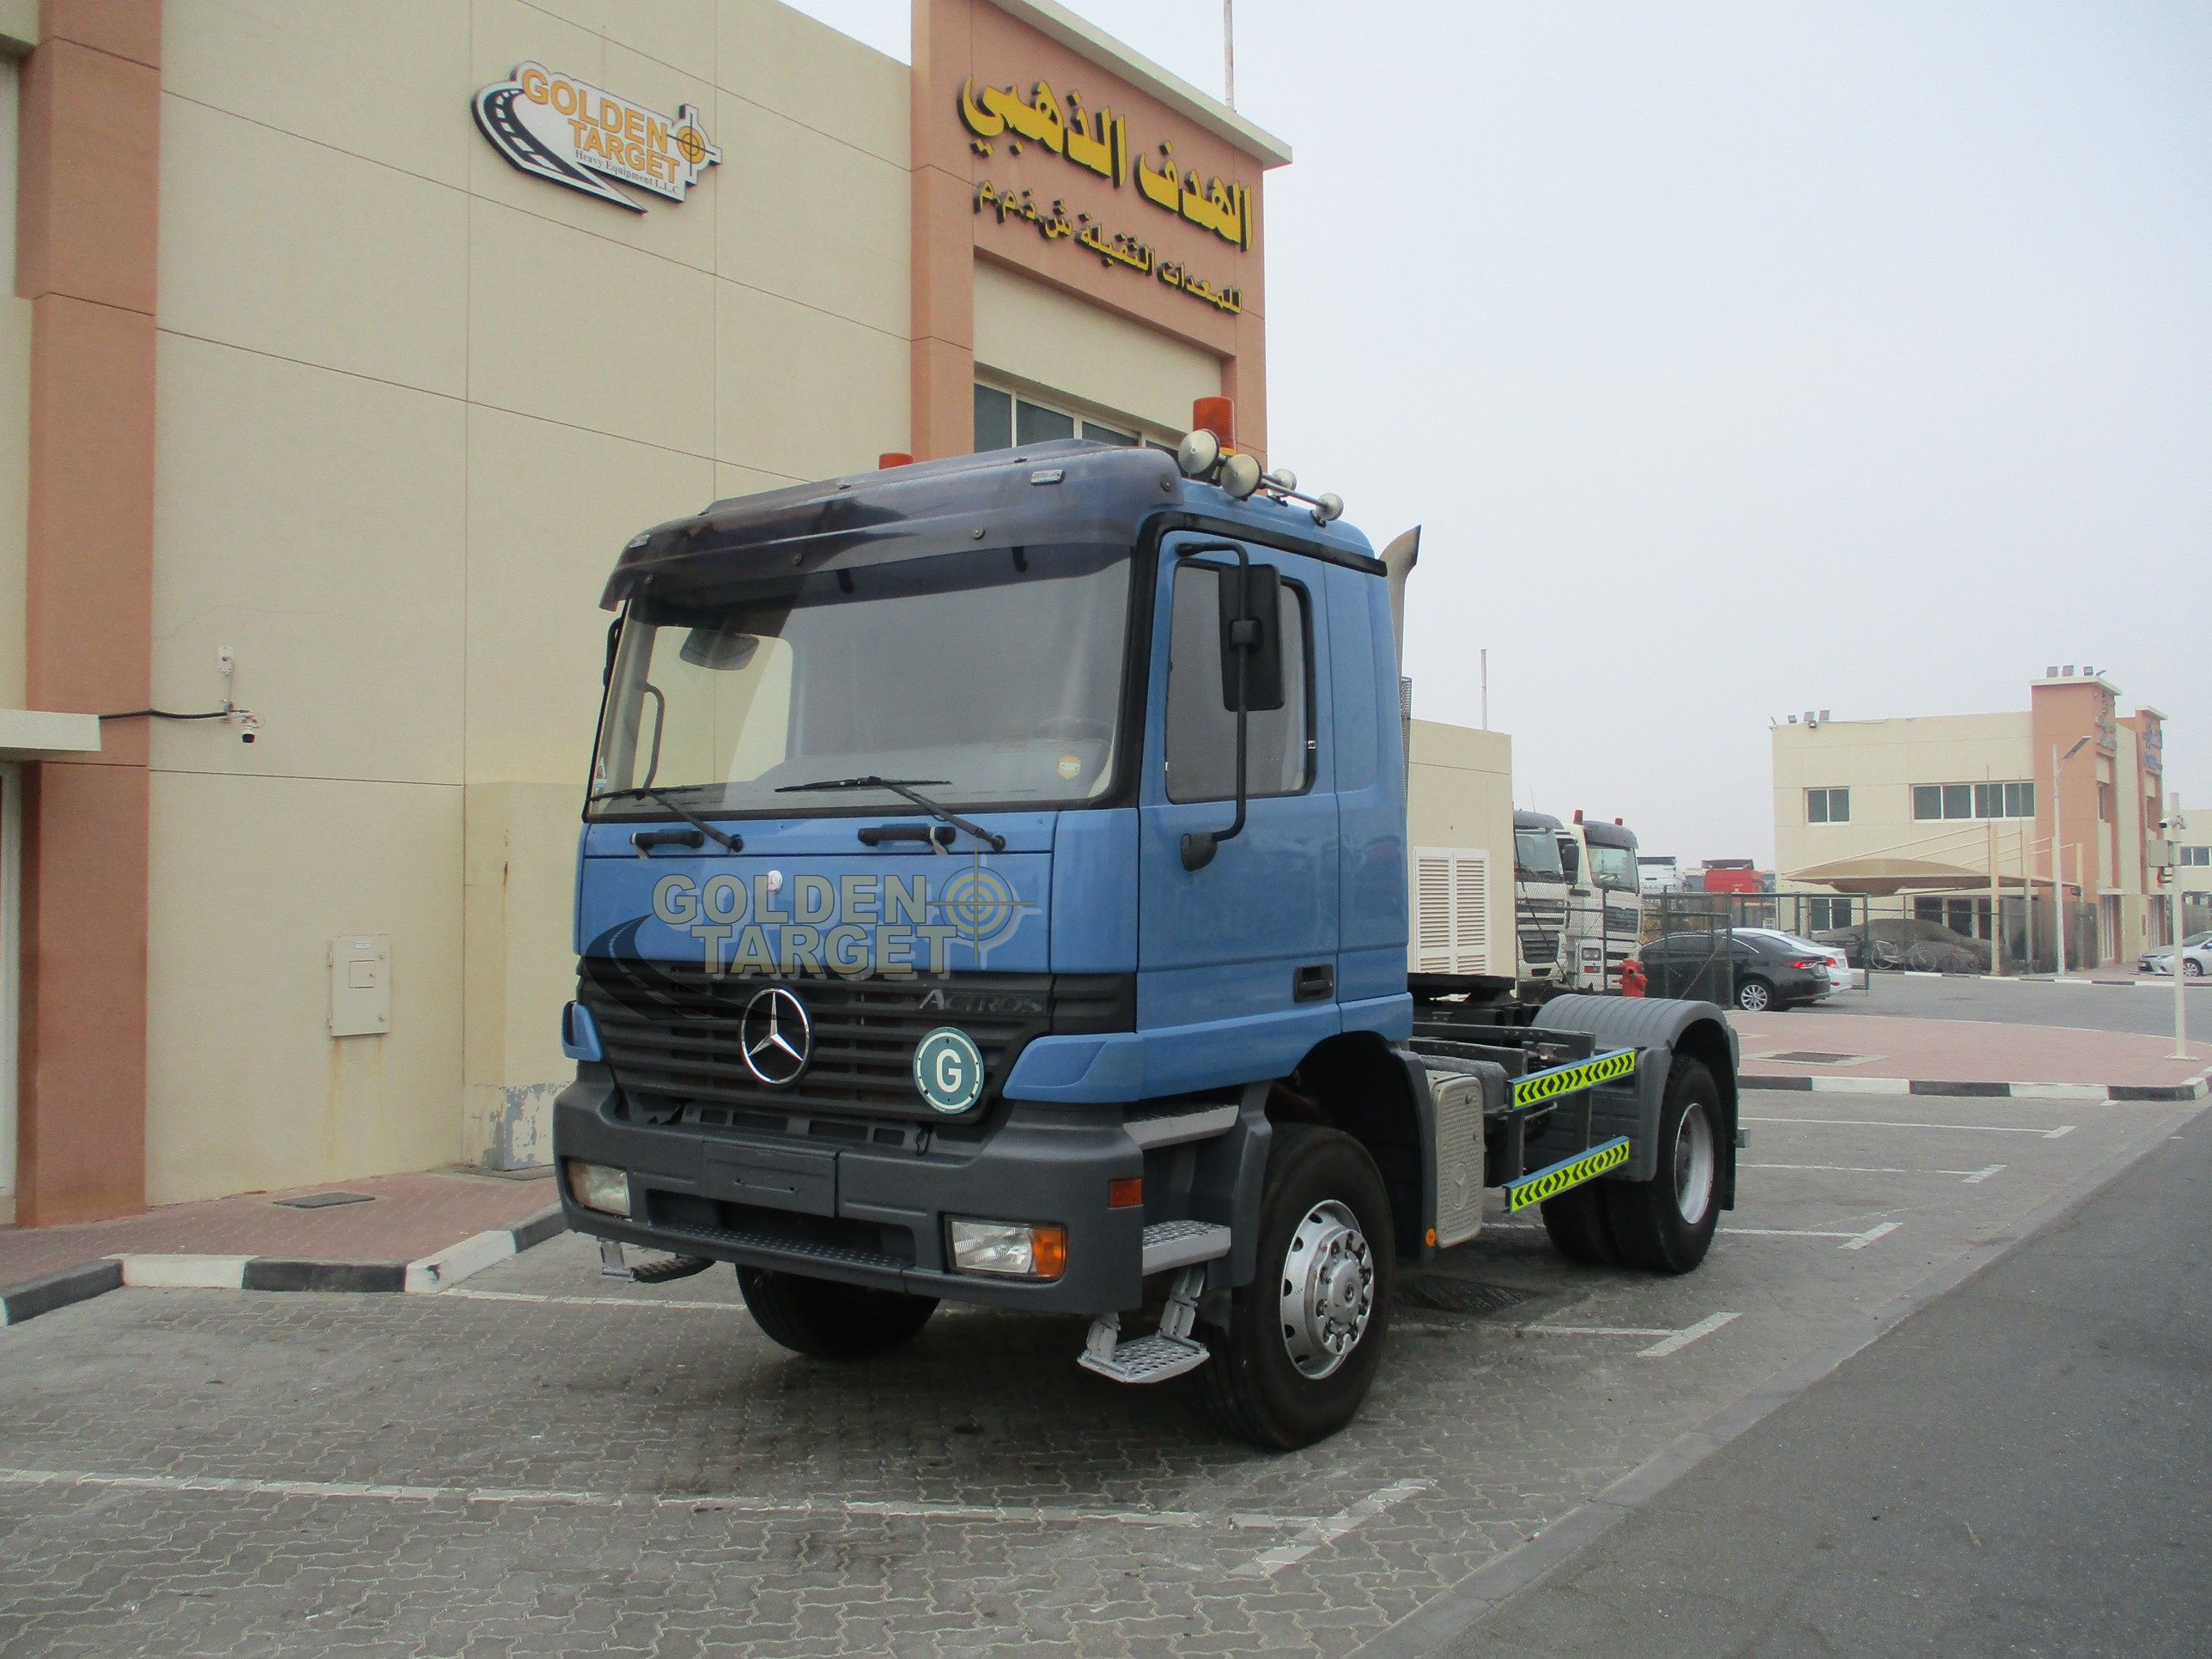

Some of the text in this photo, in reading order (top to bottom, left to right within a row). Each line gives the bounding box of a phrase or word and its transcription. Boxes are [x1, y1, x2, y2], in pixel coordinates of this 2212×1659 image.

[522, 68, 668, 154] GOLDEN
[568, 118, 680, 183] TARGET
[575, 149, 603, 168] Heavy
[605, 160, 653, 185] Equipment
[959, 74, 1253, 252] الهدف الذهبي
[1075, 211, 1155, 276] الثقيلة
[1158, 261, 1243, 314] للمعدات
[936, 1048, 962, 1093] G
